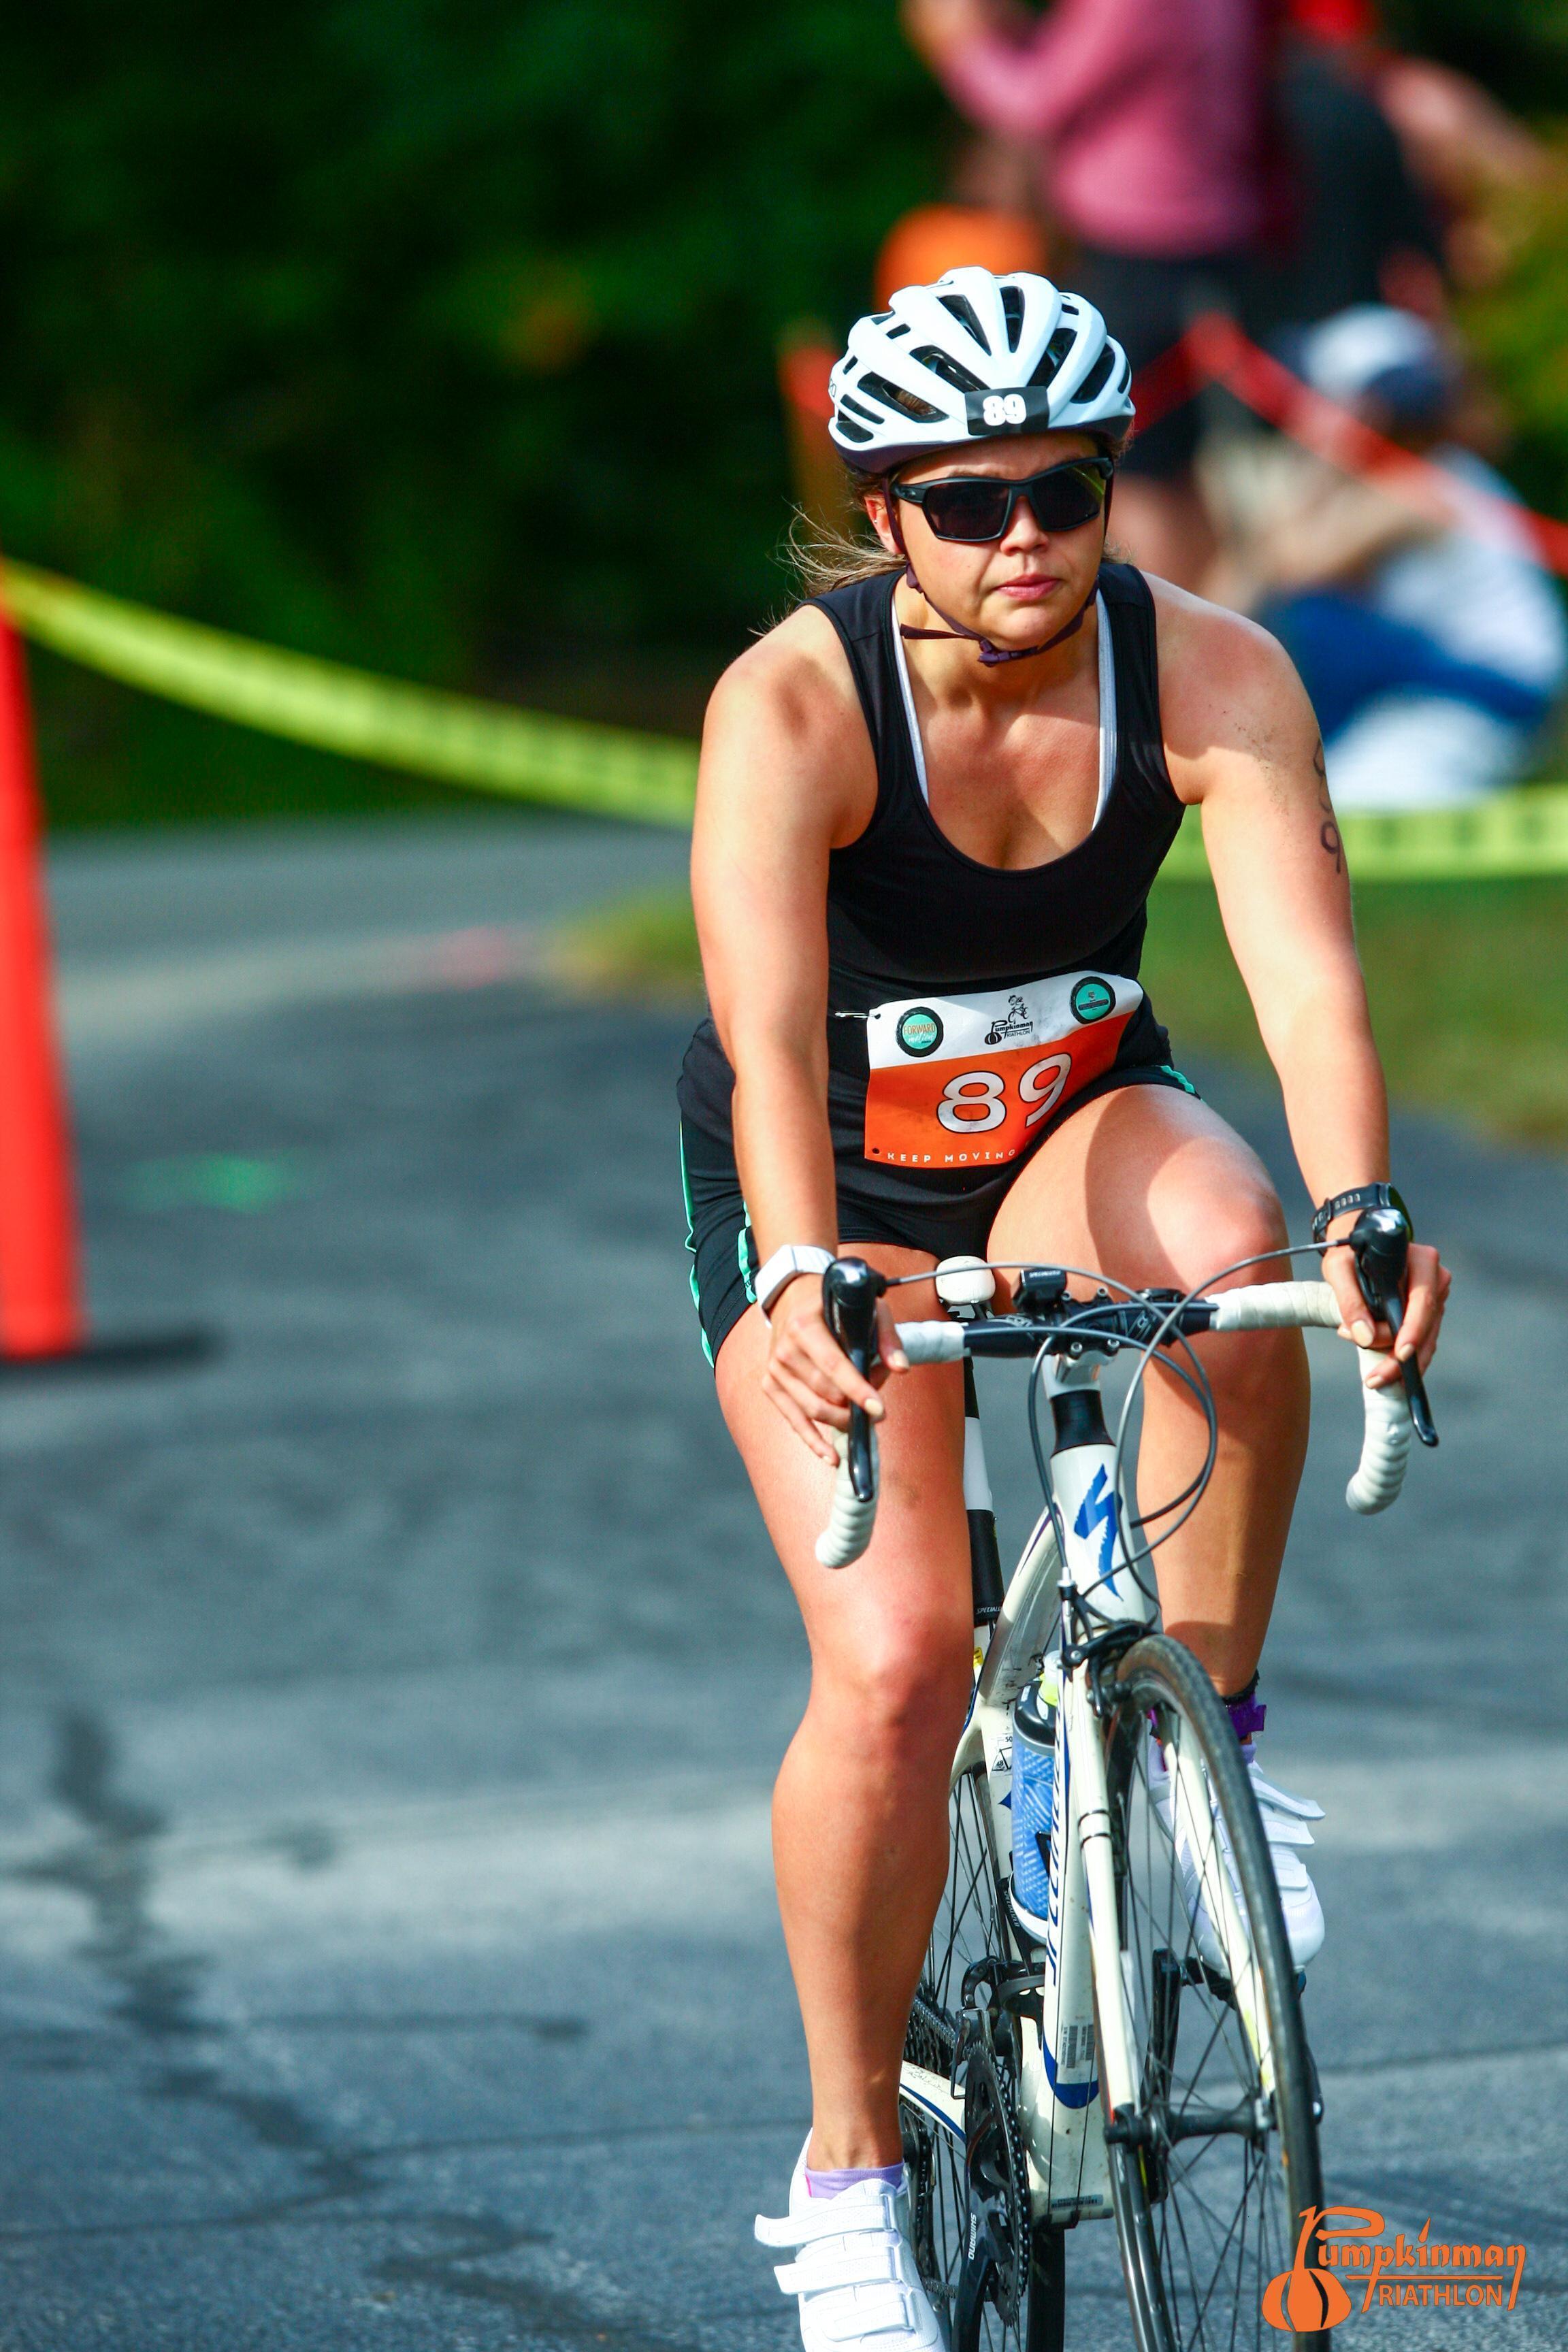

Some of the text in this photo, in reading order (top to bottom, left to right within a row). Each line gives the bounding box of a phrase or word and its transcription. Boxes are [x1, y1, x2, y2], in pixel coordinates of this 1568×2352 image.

[982, 393, 1027, 426] 89
[903, 1023, 936, 1035] FORWARD
[991, 1019, 1033, 1039] Pumpkinman
[936, 1053, 1072, 1133] 89
[887, 1149, 1015, 1163] KEEP MOVING
[968, 2212, 977, 2260] SHIMANO
